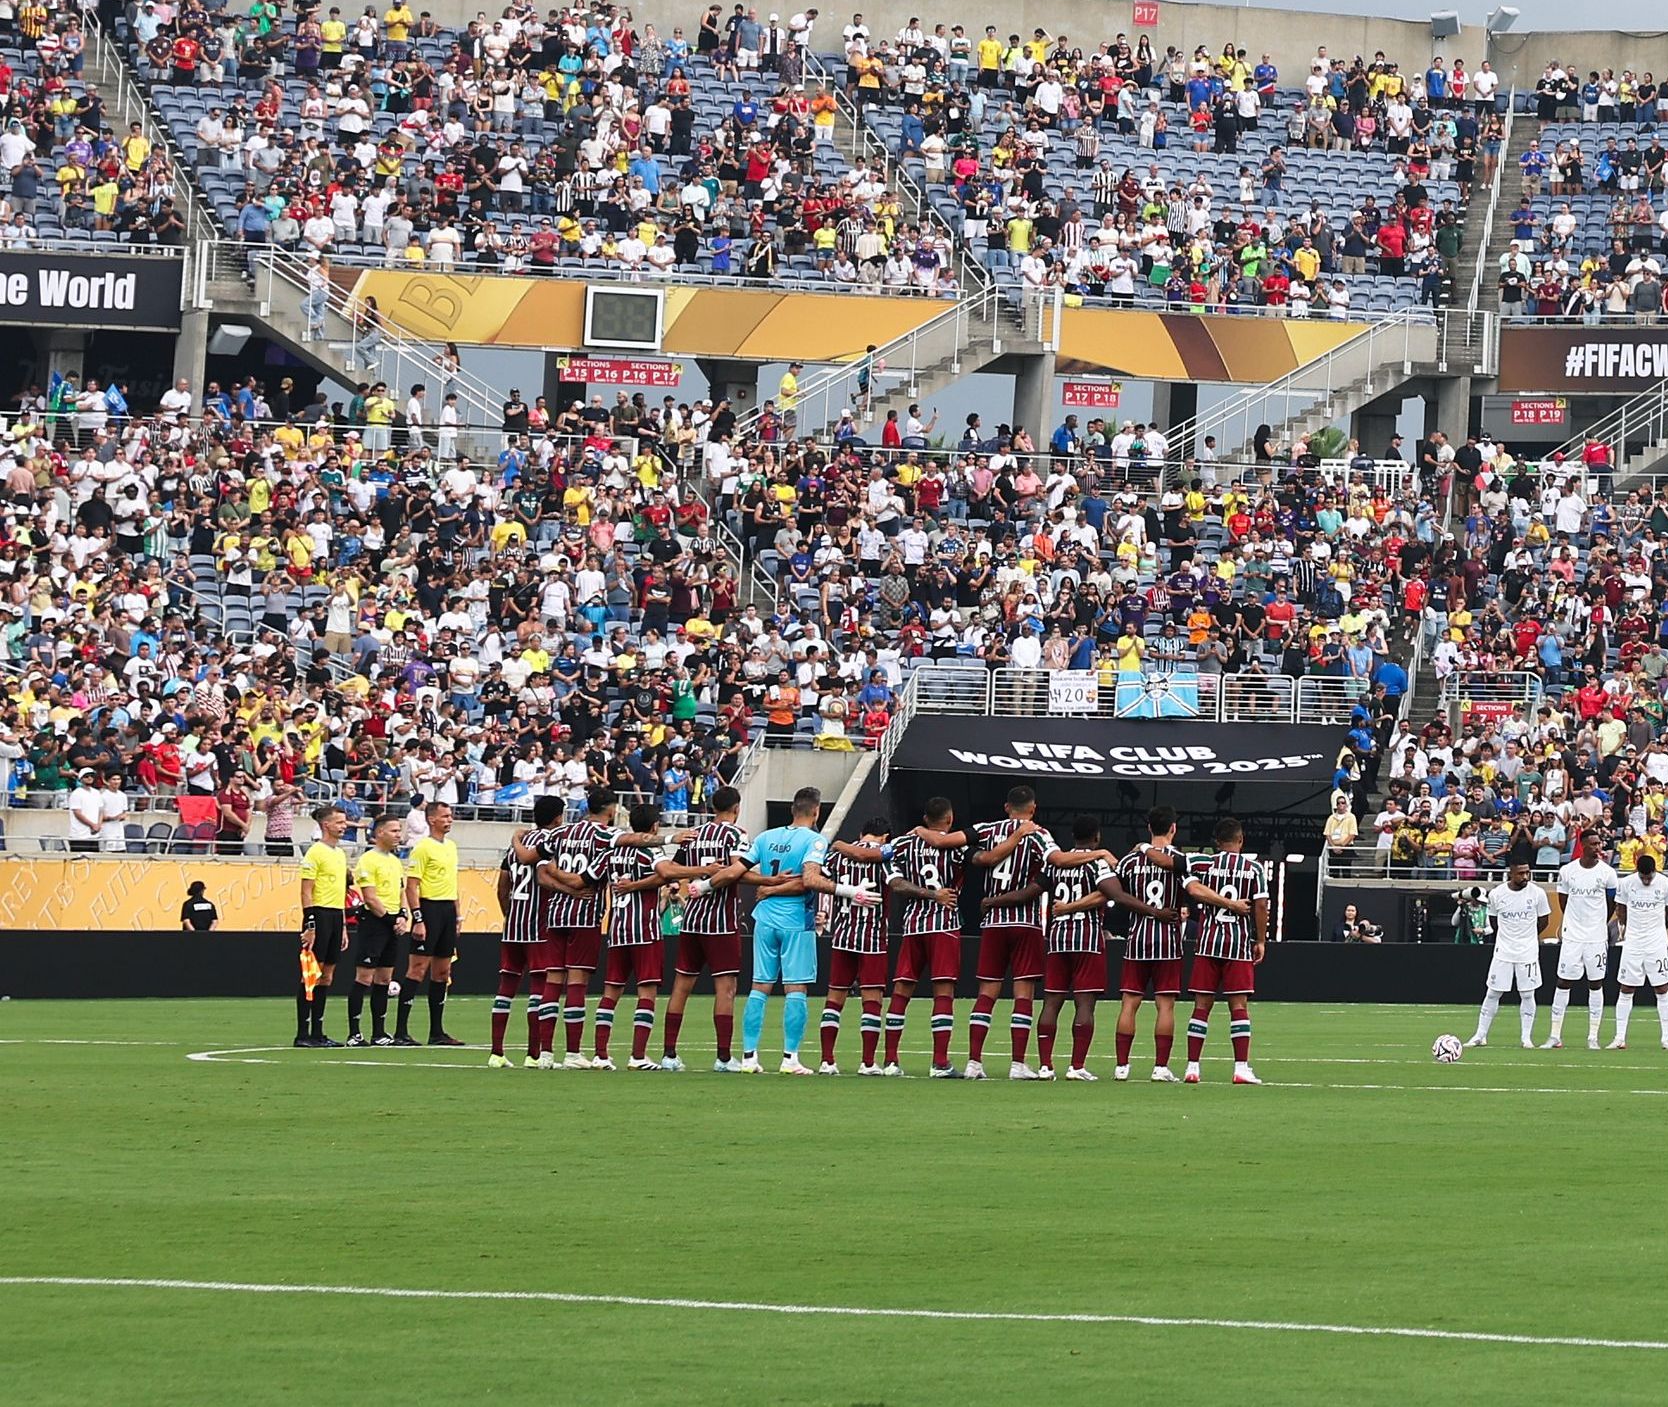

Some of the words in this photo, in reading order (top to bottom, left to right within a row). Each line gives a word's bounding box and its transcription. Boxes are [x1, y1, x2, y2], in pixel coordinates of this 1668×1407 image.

[1135, 7, 1156, 20] P17
[38, 269, 136, 310] World
[564, 368, 571, 376] P
[575, 369, 587, 377] 15
[594, 369, 601, 378] P
[605, 370, 618, 378] 16
[623, 370, 630, 379] P
[634, 371, 647, 379] 16
[653, 372, 660, 380] P
[664, 372, 676, 381] 17
[572, 360, 610, 368] SECTIONS
[631, 362, 669, 370] SECTIONS
[949, 748, 1104, 775] WORLD
[1111, 764, 1195, 776] CUP
[1011, 741, 1105, 762] FIFA
[1110, 745, 1217, 762] CLUB
[510, 862, 532, 900] 12
[993, 860, 1011, 891] 4
[1054, 883, 1087, 921] 21
[1145, 879, 1165, 914] 8
[1501, 911, 1529, 919] SAVVY
[1525, 962, 1537, 978] 77
[1656, 958, 1668, 973] 20
